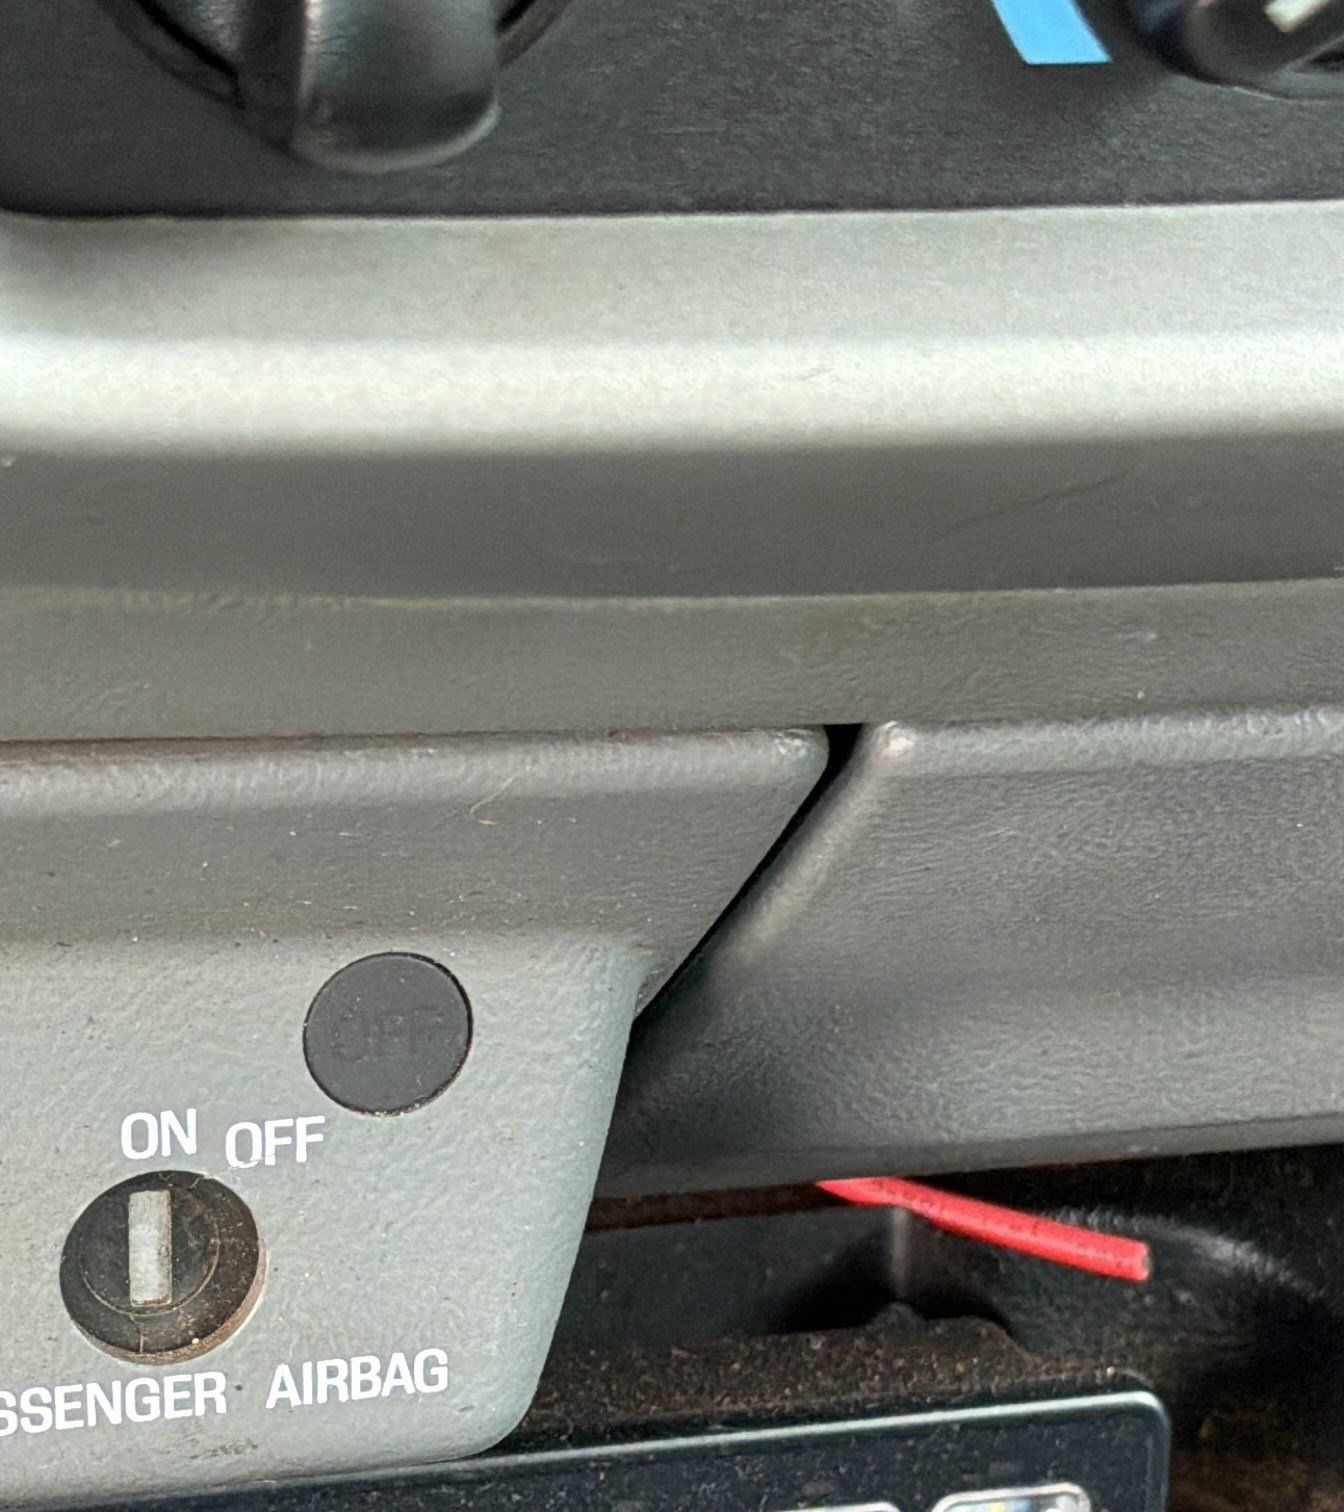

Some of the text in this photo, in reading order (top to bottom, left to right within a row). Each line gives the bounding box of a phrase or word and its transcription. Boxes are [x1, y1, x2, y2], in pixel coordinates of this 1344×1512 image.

[120, 1107, 326, 1168] ON OFF
[265, 1348, 449, 1410] AIRBAG
